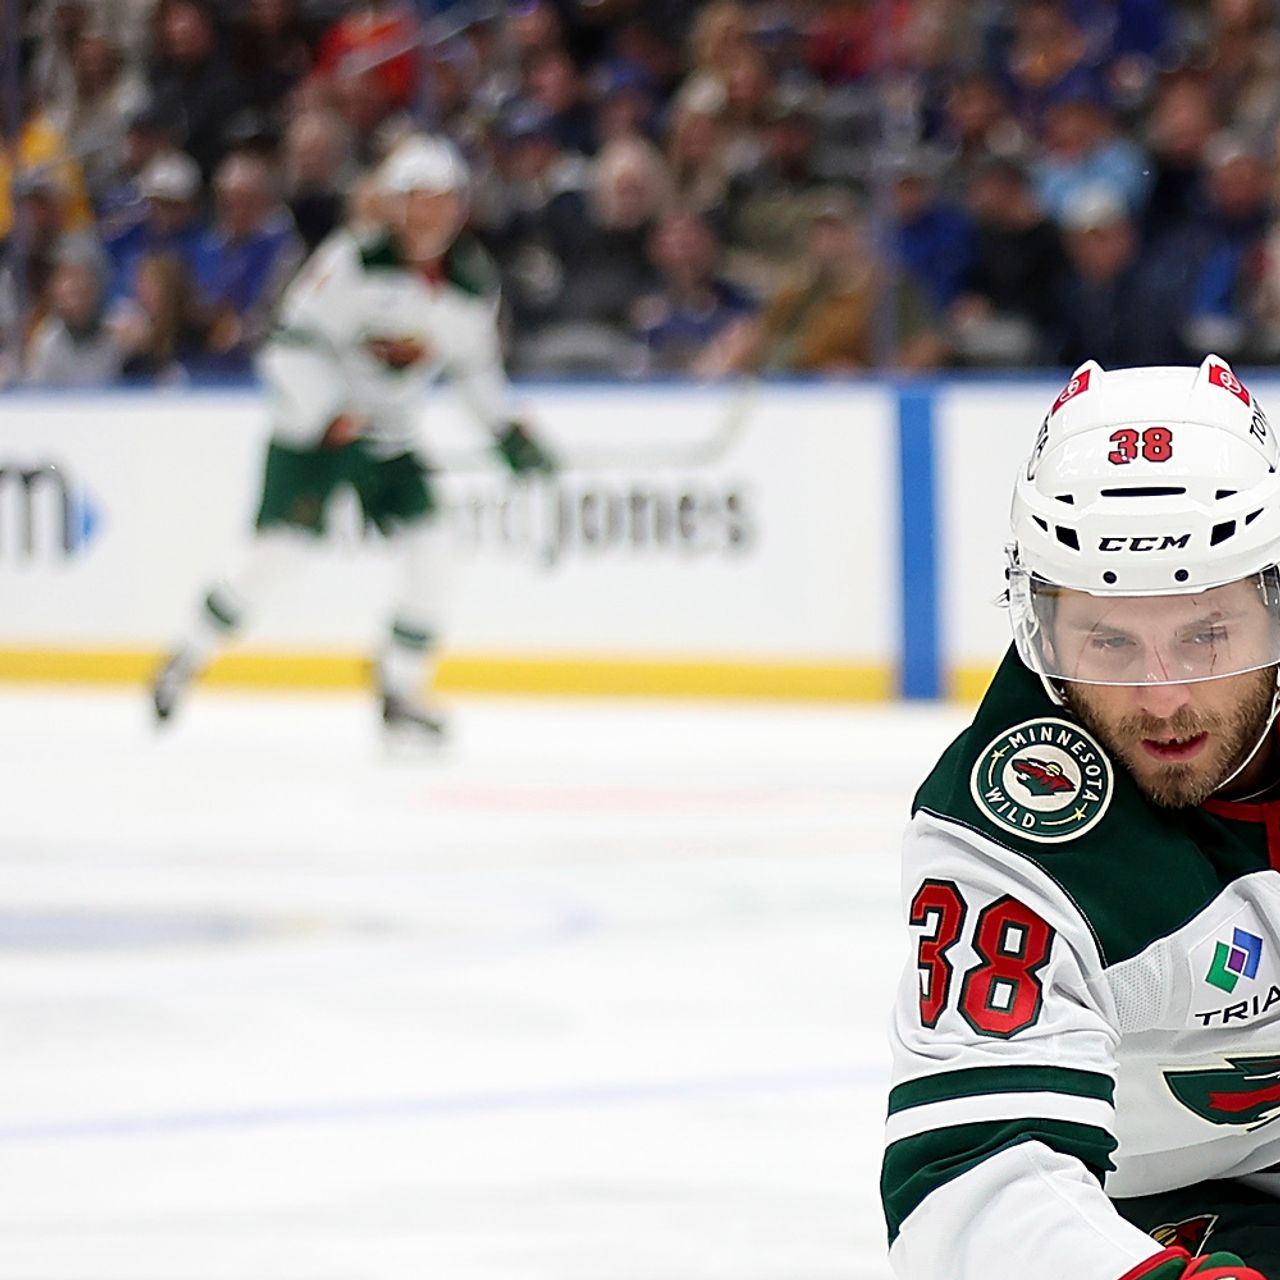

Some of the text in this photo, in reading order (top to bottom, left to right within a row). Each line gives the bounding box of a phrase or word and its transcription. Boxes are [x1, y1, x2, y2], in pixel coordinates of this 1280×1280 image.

[1107, 426, 1174, 466] 38
[1098, 533, 1192, 553] CCM
[1008, 726, 1104, 803] MINNESOTA
[984, 786, 1037, 829] WILD
[909, 877, 1056, 1040] 38
